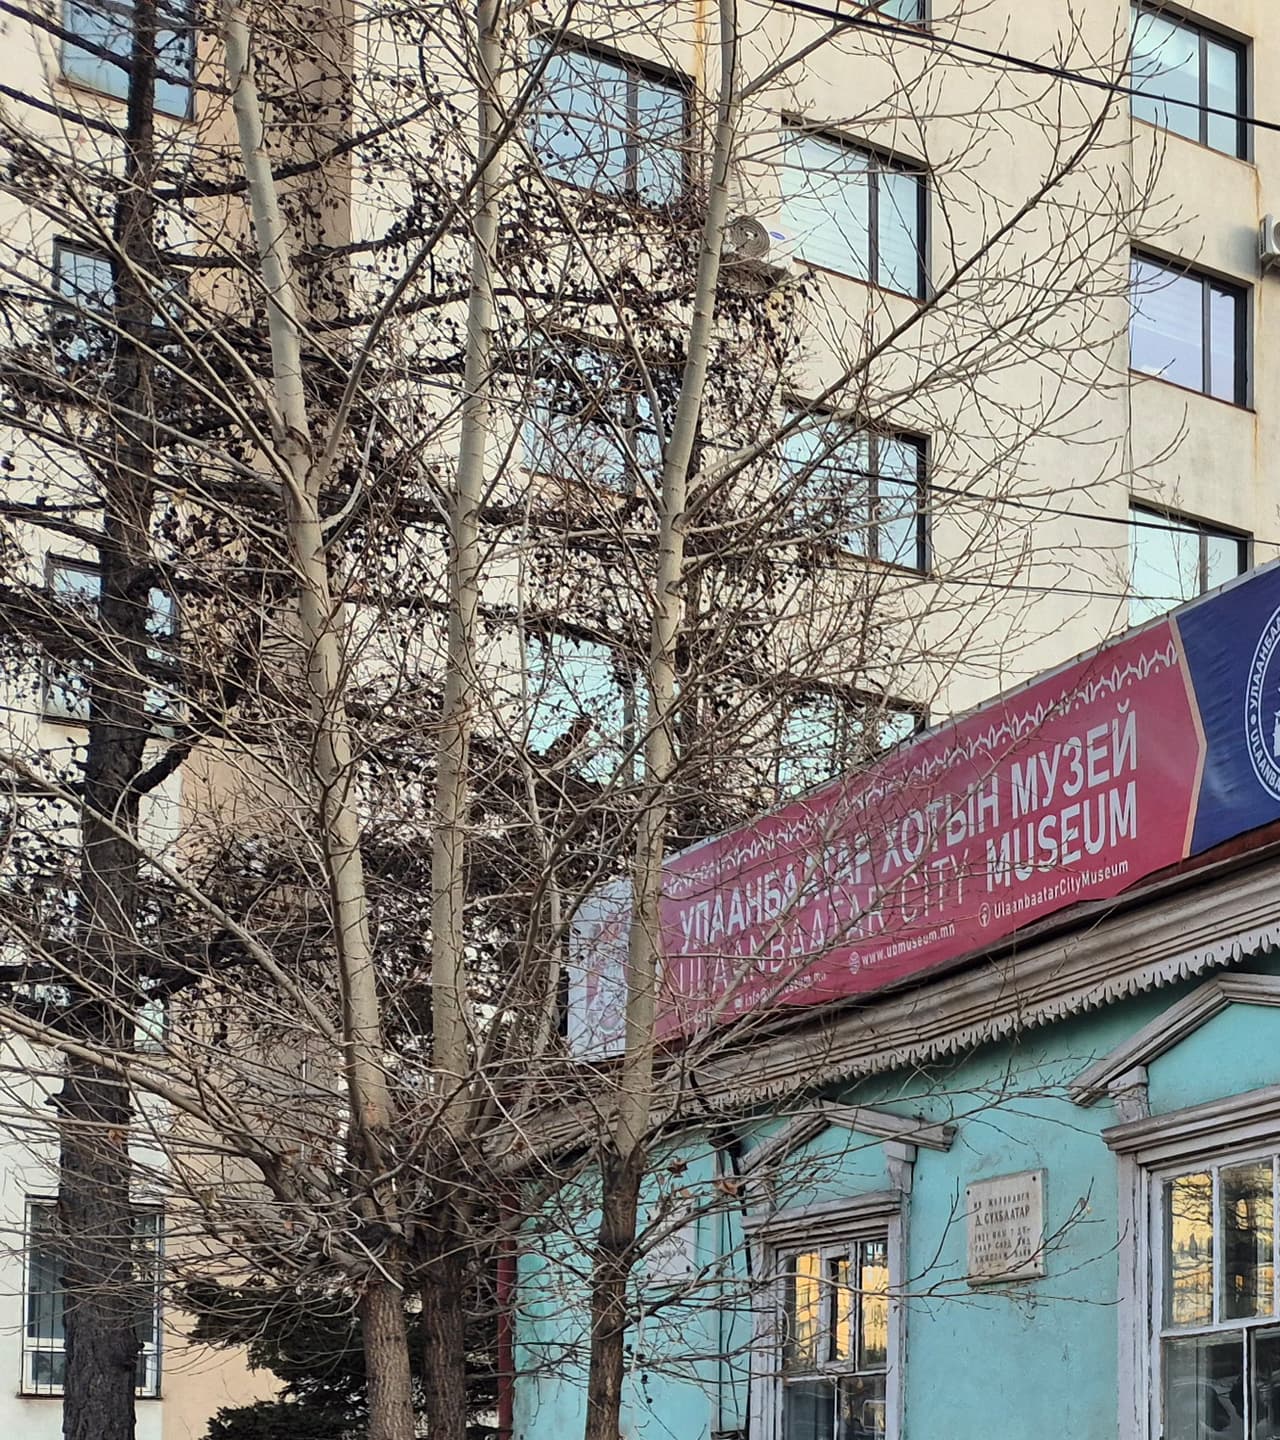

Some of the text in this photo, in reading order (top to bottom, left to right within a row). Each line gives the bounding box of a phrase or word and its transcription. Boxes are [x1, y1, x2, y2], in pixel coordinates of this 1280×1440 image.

[881, 773, 999, 873] ХОТЫН
[1010, 698, 1138, 820] МУЗЕЙ
[900, 849, 968, 922] CITY
[986, 780, 1138, 893] MUSEUM
[994, 858, 1129, 921] UlaanbaatarCityMuseum
